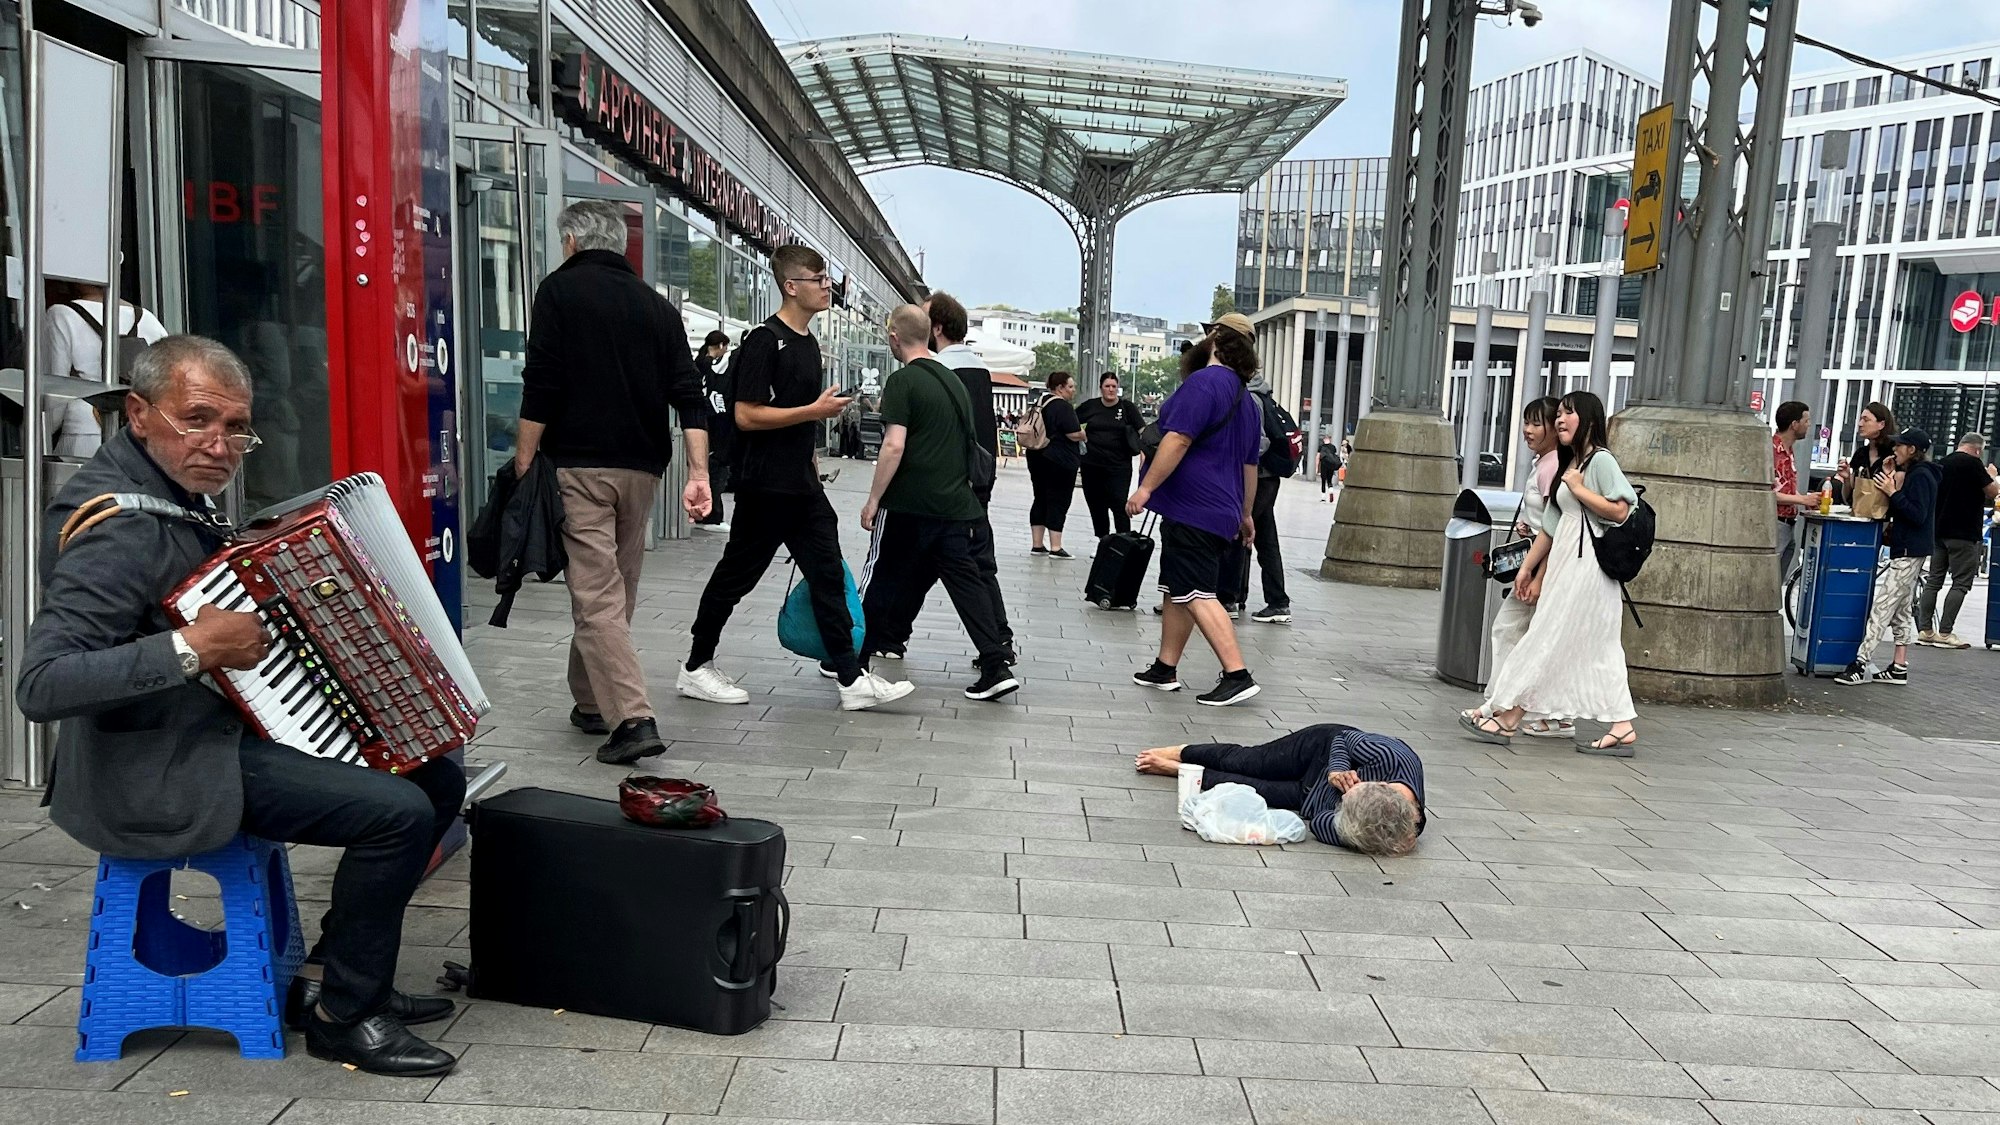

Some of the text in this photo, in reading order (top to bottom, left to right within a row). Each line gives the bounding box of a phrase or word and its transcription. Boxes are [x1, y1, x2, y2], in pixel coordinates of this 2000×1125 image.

[598, 67, 677, 177] APOTHEKE
[692, 145, 762, 239] INTERNATIONAL
[1642, 121, 1666, 157] TAXI
